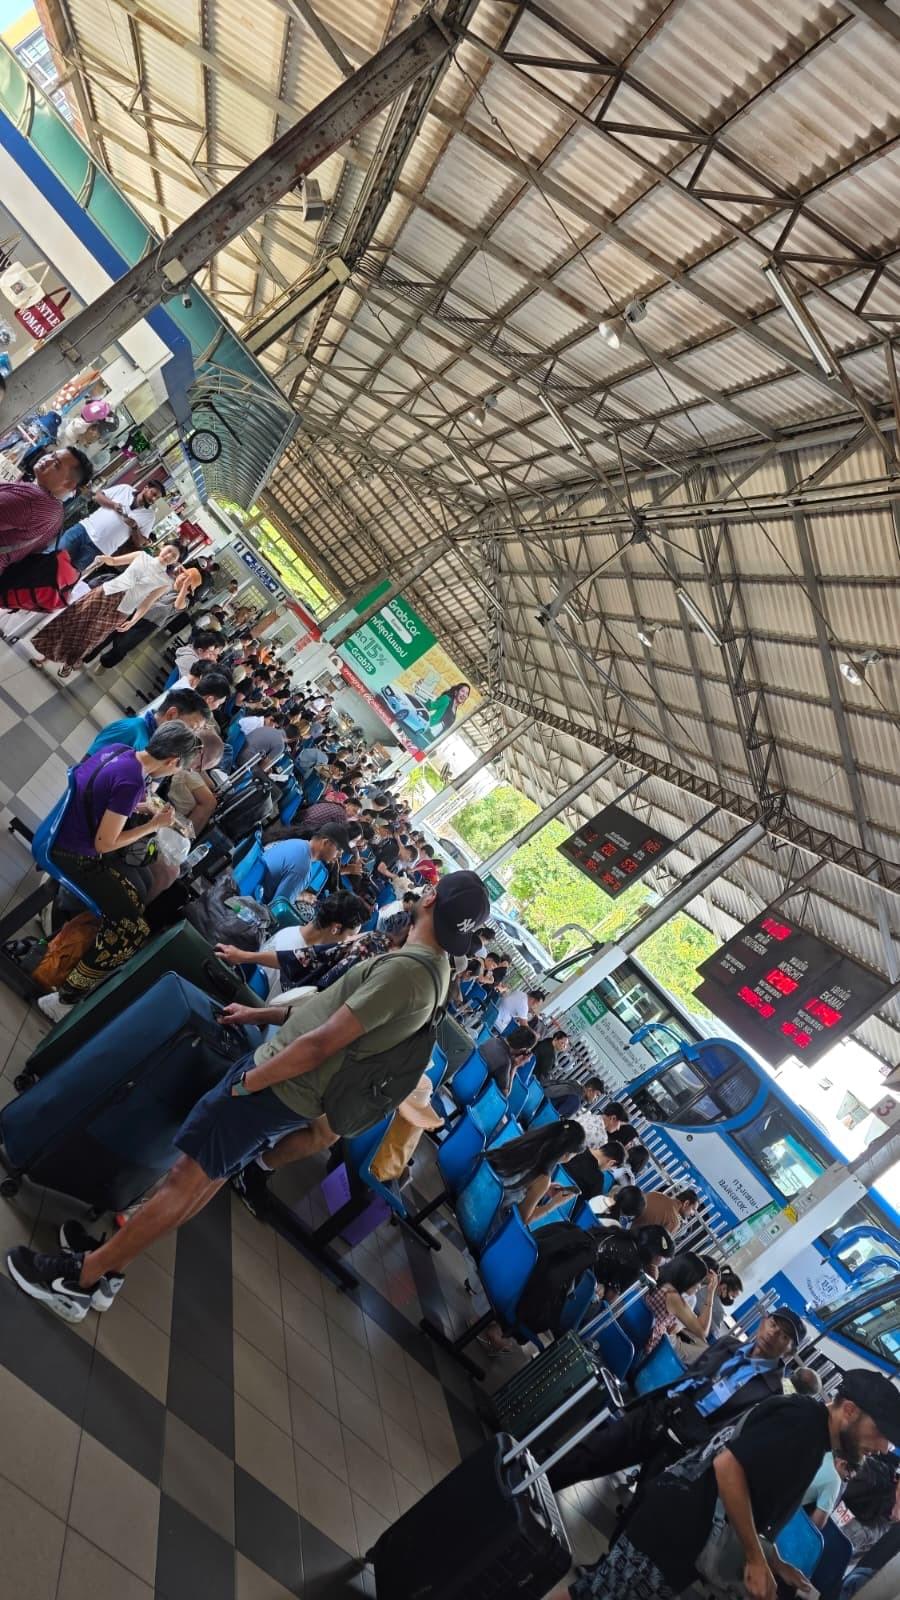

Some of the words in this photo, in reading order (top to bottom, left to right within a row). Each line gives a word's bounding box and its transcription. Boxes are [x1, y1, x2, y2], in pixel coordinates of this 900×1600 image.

[35, 300, 61, 328] ENTLE
[389, 599, 421, 637] GrabCar
[370, 616, 408, 658] กที่สุดในแอป
[351, 647, 374, 672] Grab15
[820, 990, 846, 1011] EKAMAI
[877, 1099, 896, 1115] 3
[718, 1179, 748, 1212] BANGKOK
